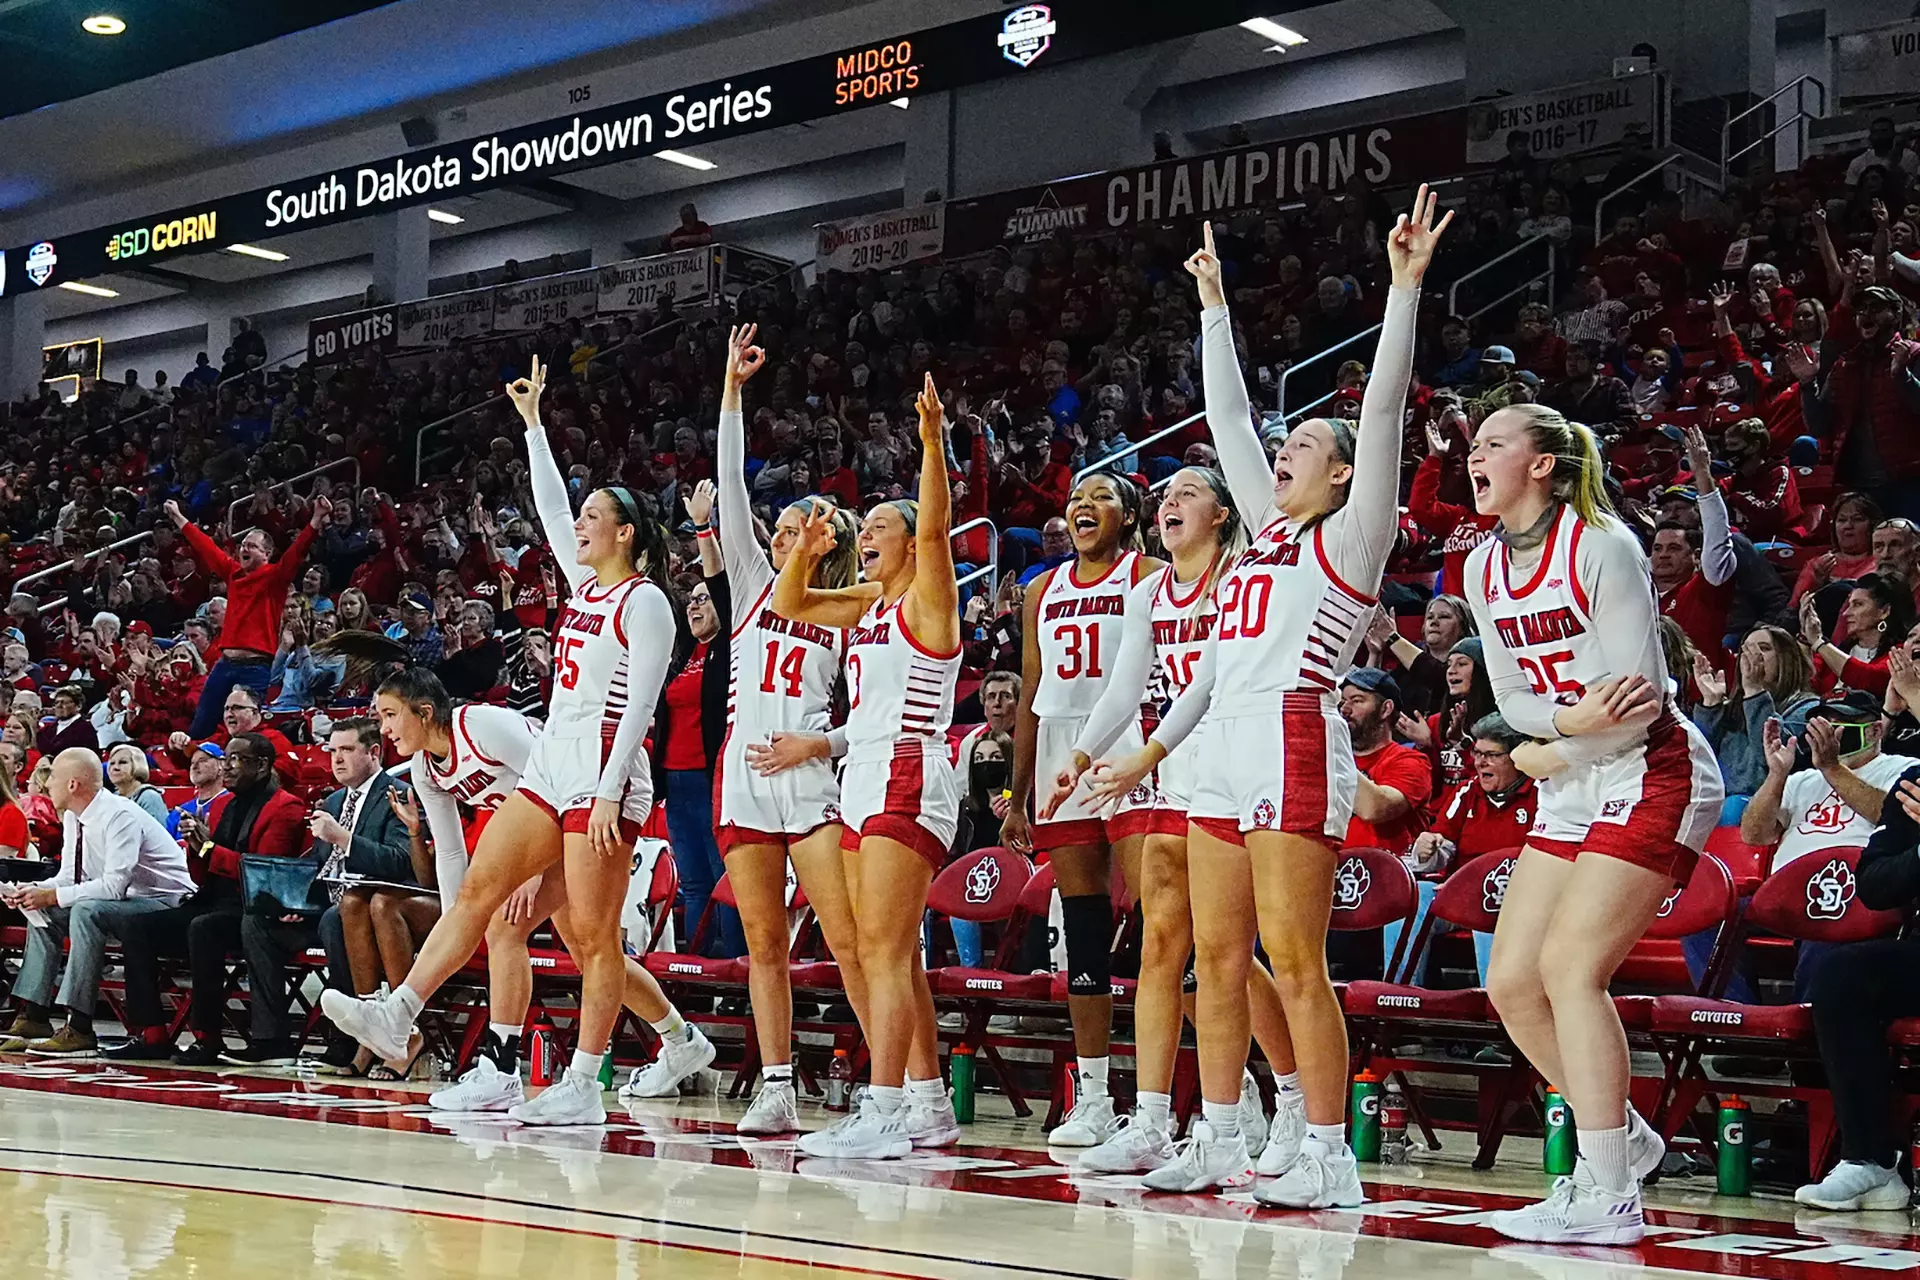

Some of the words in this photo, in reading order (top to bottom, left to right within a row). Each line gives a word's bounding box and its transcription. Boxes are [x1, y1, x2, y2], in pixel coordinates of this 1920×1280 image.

[836, 41, 911, 79] MIDCO
[568, 85, 591, 104] 105
[835, 66, 919, 104] SPORTS
[1536, 87, 1634, 123] BASKETBALL
[1528, 119, 1597, 152] 016-17
[265, 174, 346, 227] South
[356, 159, 461, 207] Dakota
[471, 117, 652, 181] Showdown
[665, 82, 772, 138] Series
[1107, 128, 1392, 227] CHAMPIONS
[824, 225, 871, 250] WOMEN'S
[873, 213, 939, 241] BASKETBALL
[1002, 204, 1088, 239] SUMMIT
[851, 240, 908, 268] 2019-20
[603, 266, 644, 288] WOMEN'S
[647, 256, 704, 280] BASKETBALL
[541, 278, 594, 299] BASKETBALL
[628, 281, 677, 306] 2017-18
[523, 302, 568, 326] 2015-16
[315, 330, 337, 358] GO
[341, 312, 393, 350] YOTES
[423, 318, 465, 342] 2014-15
[1044, 599, 1079, 623] SOUTH
[1077, 594, 1124, 616] DAKOTA
[1219, 574, 1273, 641] 20
[789, 620, 834, 650] DAKOTA
[1520, 606, 1586, 645] DAKOTA
[1054, 622, 1102, 680] 31
[760, 640, 807, 698] 14
[668, 963, 703, 974] COYOTES
[966, 978, 1002, 990] COYOTES
[1377, 994, 1421, 1009] COYOTES
[1691, 1010, 1742, 1025] COYOTES
[1360, 1095, 1378, 1115] G
[1547, 1106, 1565, 1127] G
[1723, 1122, 1743, 1145] G
